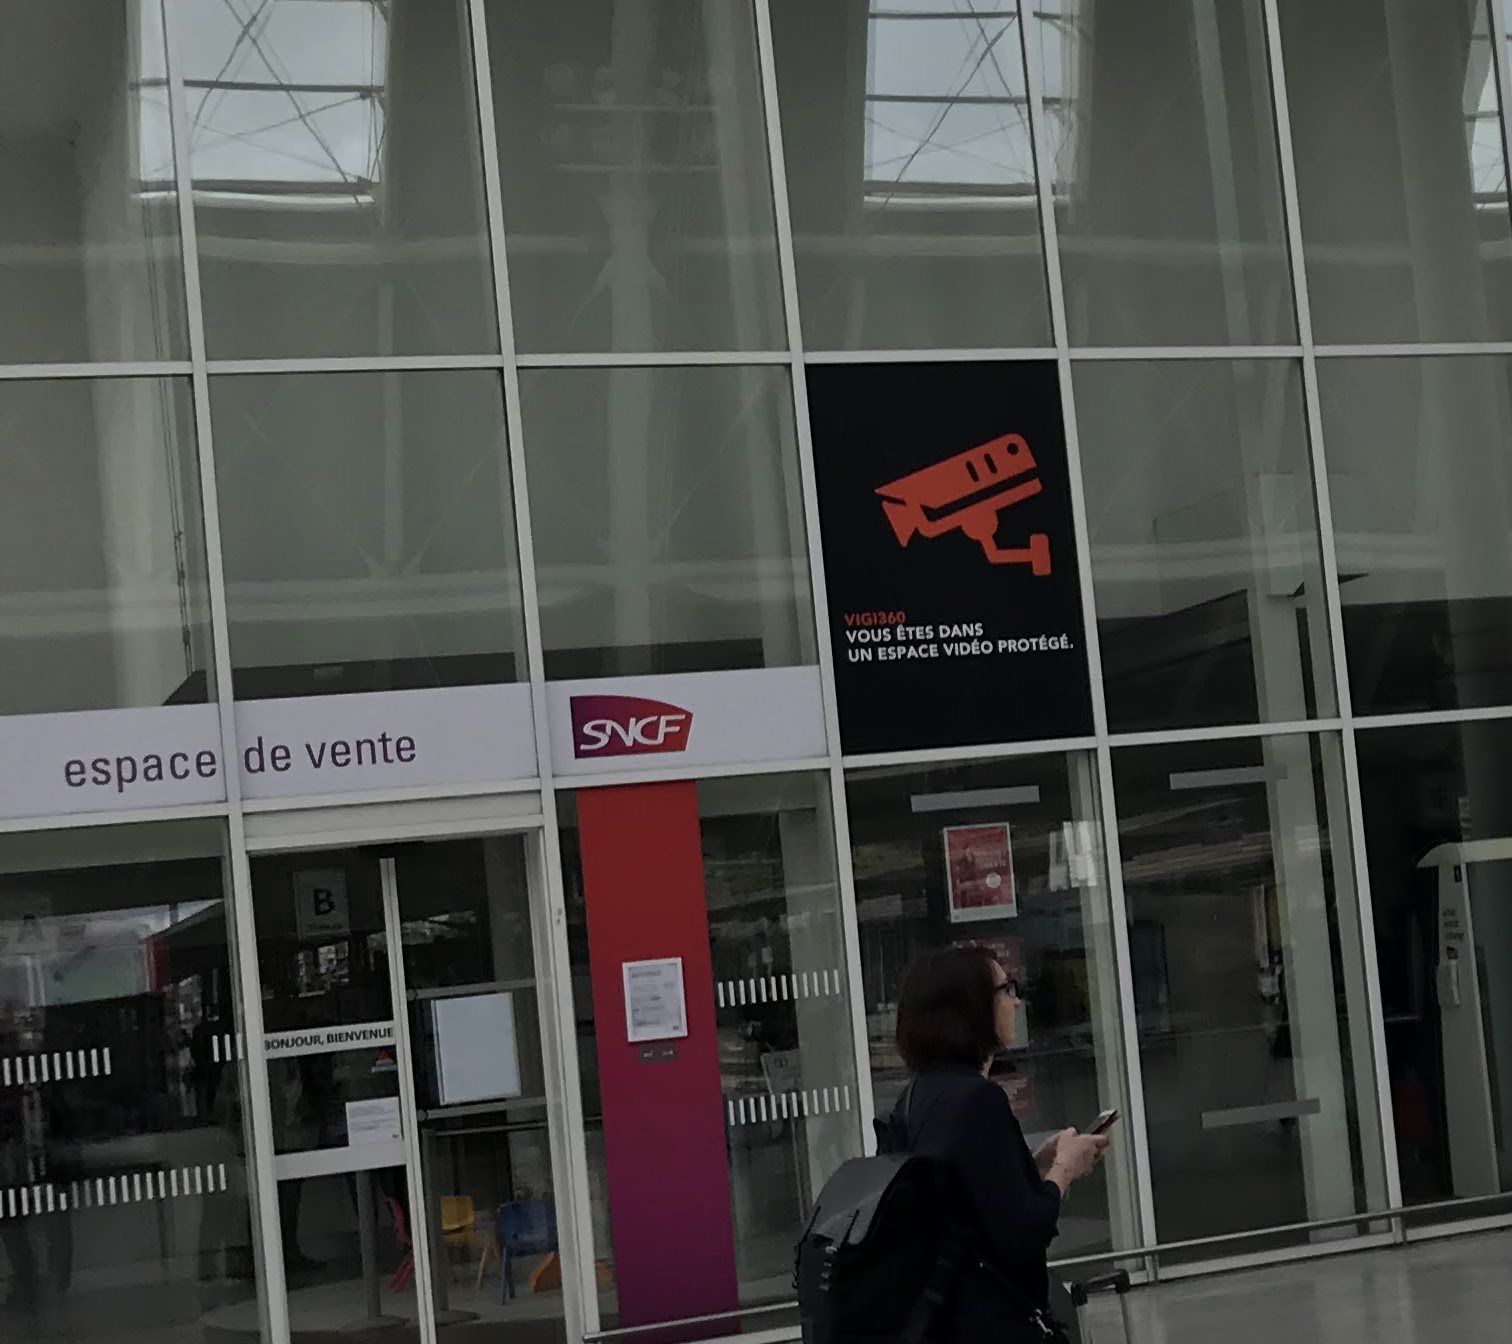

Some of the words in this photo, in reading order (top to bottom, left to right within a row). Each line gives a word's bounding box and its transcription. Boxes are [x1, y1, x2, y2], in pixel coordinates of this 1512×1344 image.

[846, 628, 892, 644] VOUS
[896, 623, 934, 641] ÊTES
[939, 622, 984, 638] DANS
[848, 648, 873, 663] UN
[878, 643, 939, 661] ESPACE
[943, 637, 993, 657] VIDÉO
[998, 632, 1075, 654] PROTÉGÉ.
[580, 713, 686, 751] SNCF
[64, 748, 218, 793] espace
[243, 736, 292, 775] de
[304, 731, 417, 770] vente
[313, 888, 335, 916] B
[326, 1027, 394, 1044] BIENVENUE
